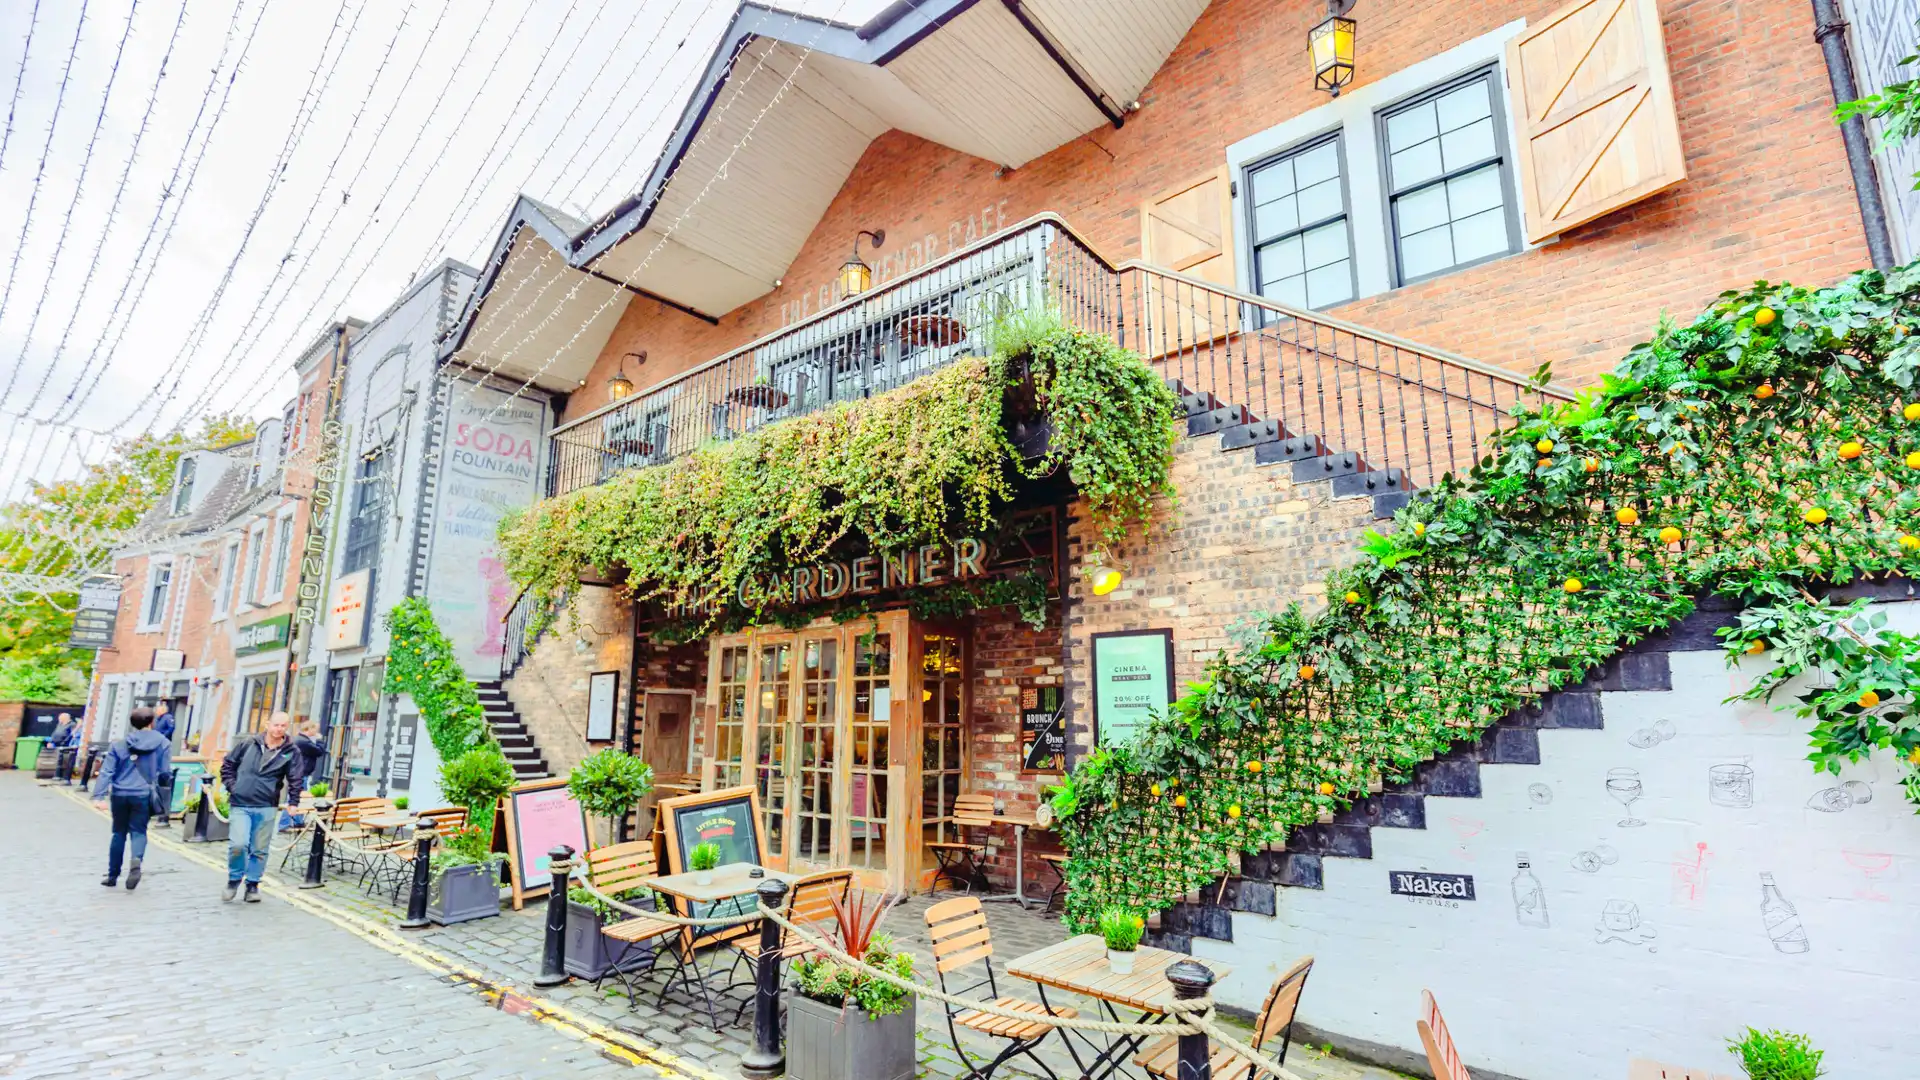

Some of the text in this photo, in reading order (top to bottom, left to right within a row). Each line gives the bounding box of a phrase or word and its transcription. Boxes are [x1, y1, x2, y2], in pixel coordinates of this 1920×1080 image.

[511, 408, 534, 419] new
[455, 423, 533, 463] SODA
[452, 449, 531, 478] FOUNTAIN
[295, 419, 342, 626] GOSVENOR
[738, 539, 986, 609] GARDENER
[1114, 665, 1148, 673] CINEMA
[1026, 713, 1053, 724] BRUNCH
[1396, 874, 1467, 897] Naked
[1408, 894, 1459, 909] Grouse
